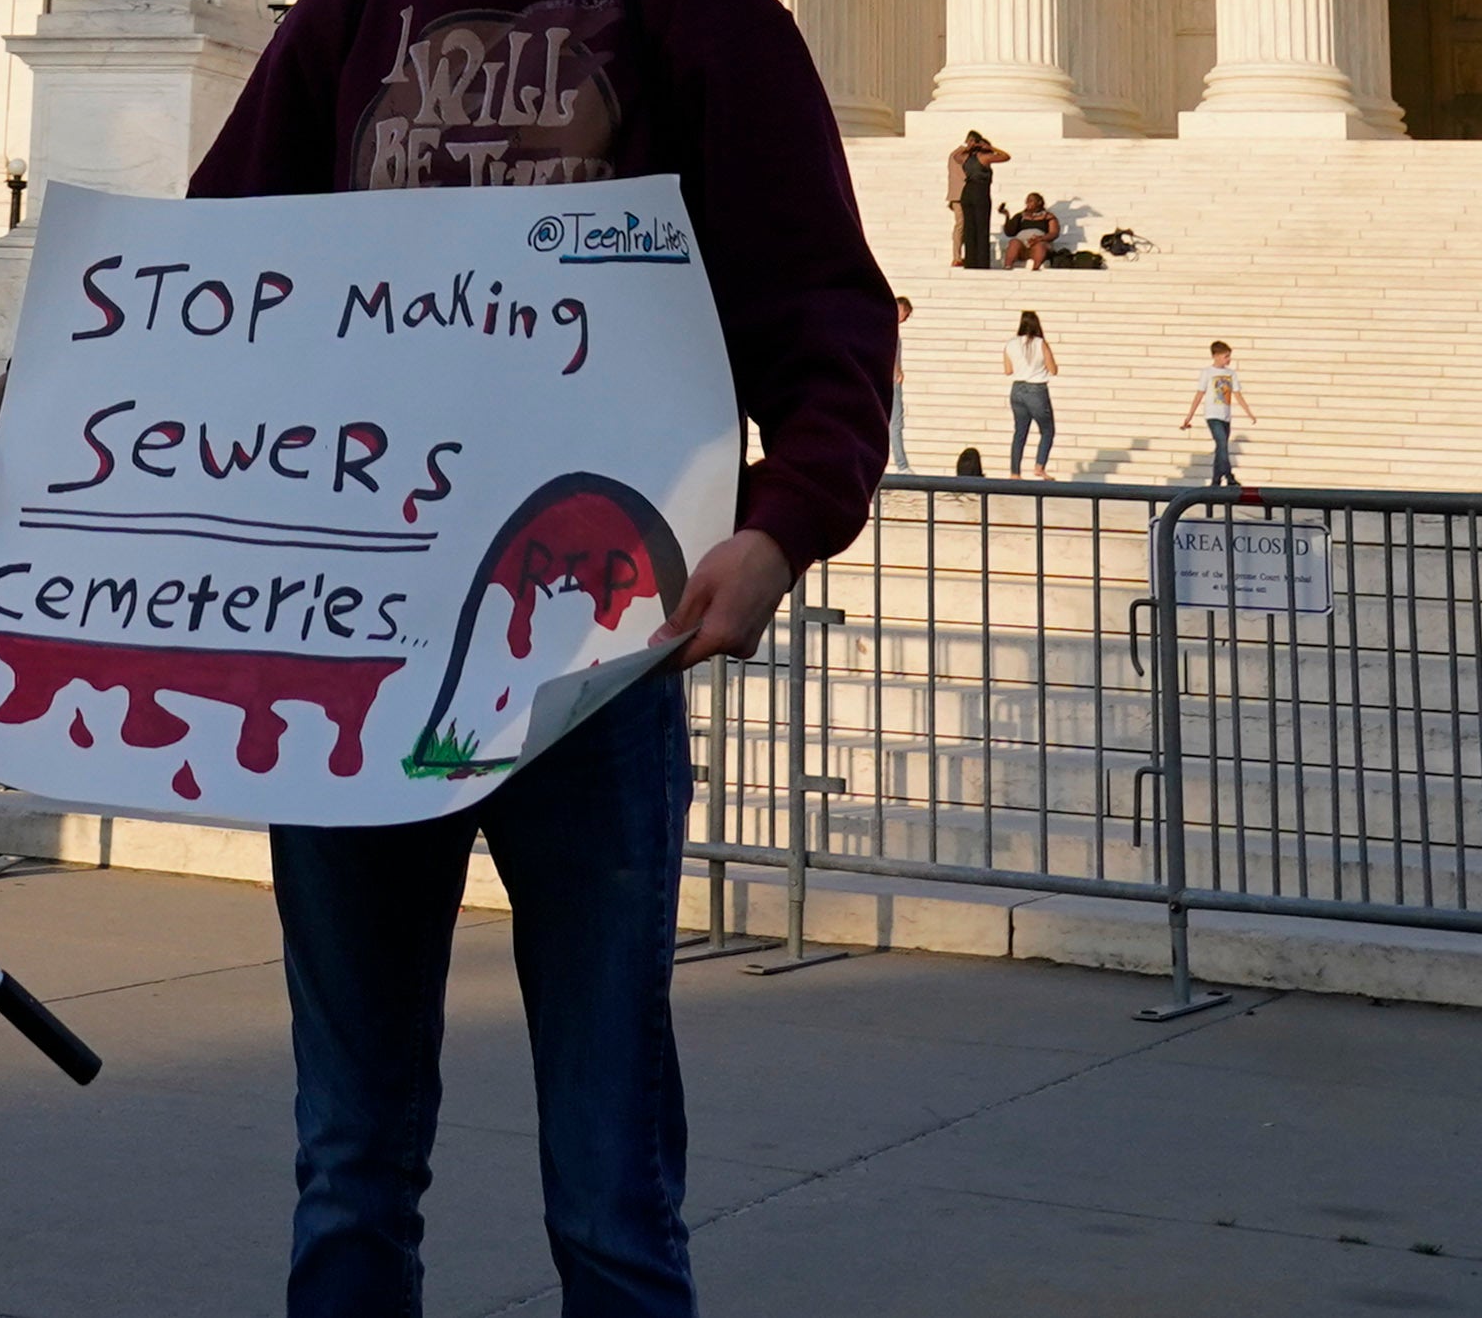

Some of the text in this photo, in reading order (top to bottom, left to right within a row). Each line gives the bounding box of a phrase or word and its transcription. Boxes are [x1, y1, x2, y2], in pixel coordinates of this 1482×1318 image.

[408, 27, 580, 127] WILL
[72, 255, 294, 343] STOP
[518, 539, 639, 612] RIP
[1234, 535, 1309, 556] CLOSD
